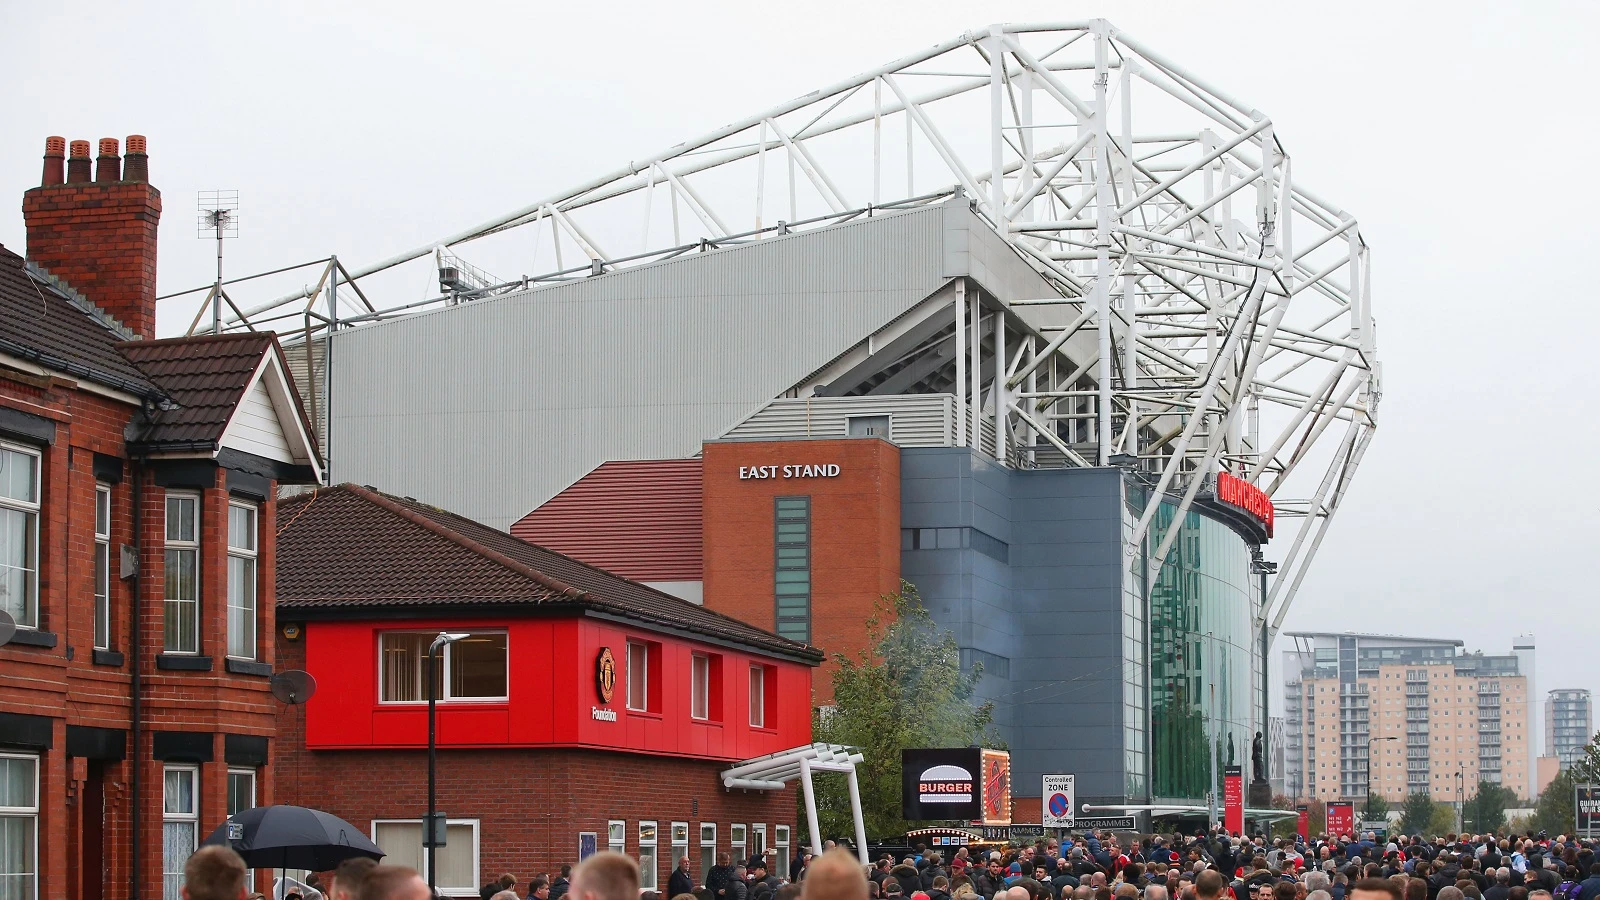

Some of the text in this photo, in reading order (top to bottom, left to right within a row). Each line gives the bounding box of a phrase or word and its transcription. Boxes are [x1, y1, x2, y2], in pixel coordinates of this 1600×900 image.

[739, 464, 840, 479] EAST STAND
[592, 706, 616, 722] Foundation
[919, 783, 972, 793] BURGER
[1074, 819, 1131, 828] PROGRAMMES
